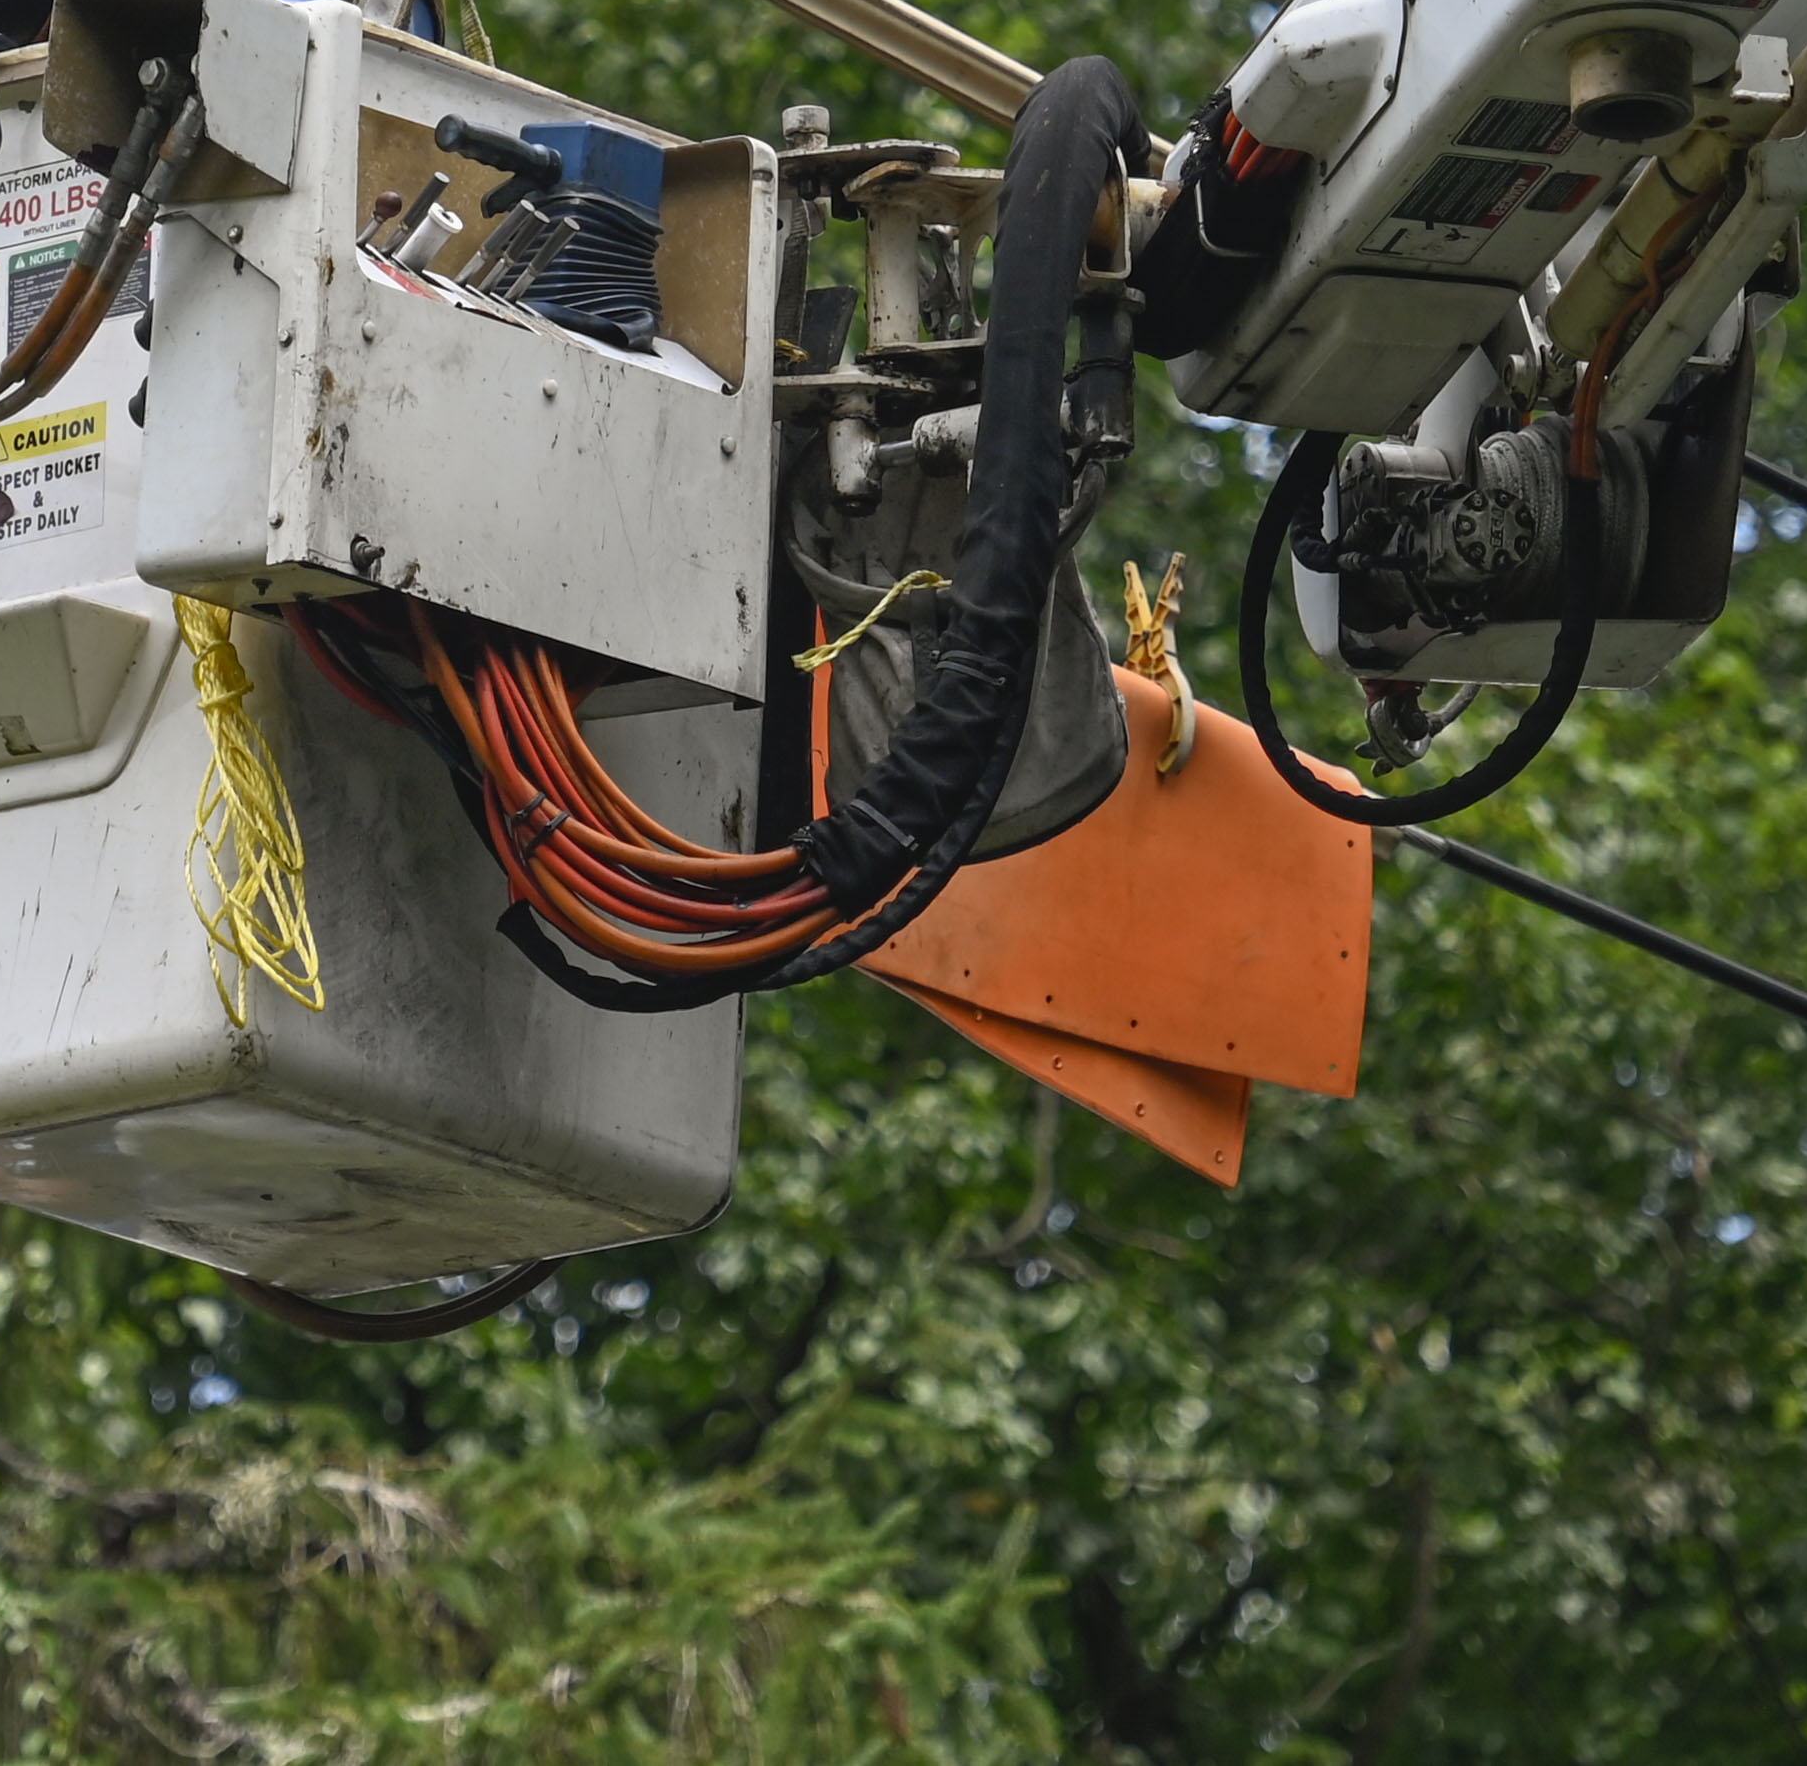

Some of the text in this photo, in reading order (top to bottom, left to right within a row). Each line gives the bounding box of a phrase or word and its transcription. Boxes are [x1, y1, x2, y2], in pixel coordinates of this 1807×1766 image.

[56, 163, 94, 182] CAPA
[51, 180, 103, 217] LBS
[23, 218, 76, 237] WITHOUT LINER
[28, 246, 66, 267] NOTICE
[13, 416, 96, 451] CAUTION
[44, 453, 101, 482] BUCKET
[32, 490, 44, 508] &
[37, 505, 80, 531] DAILY
